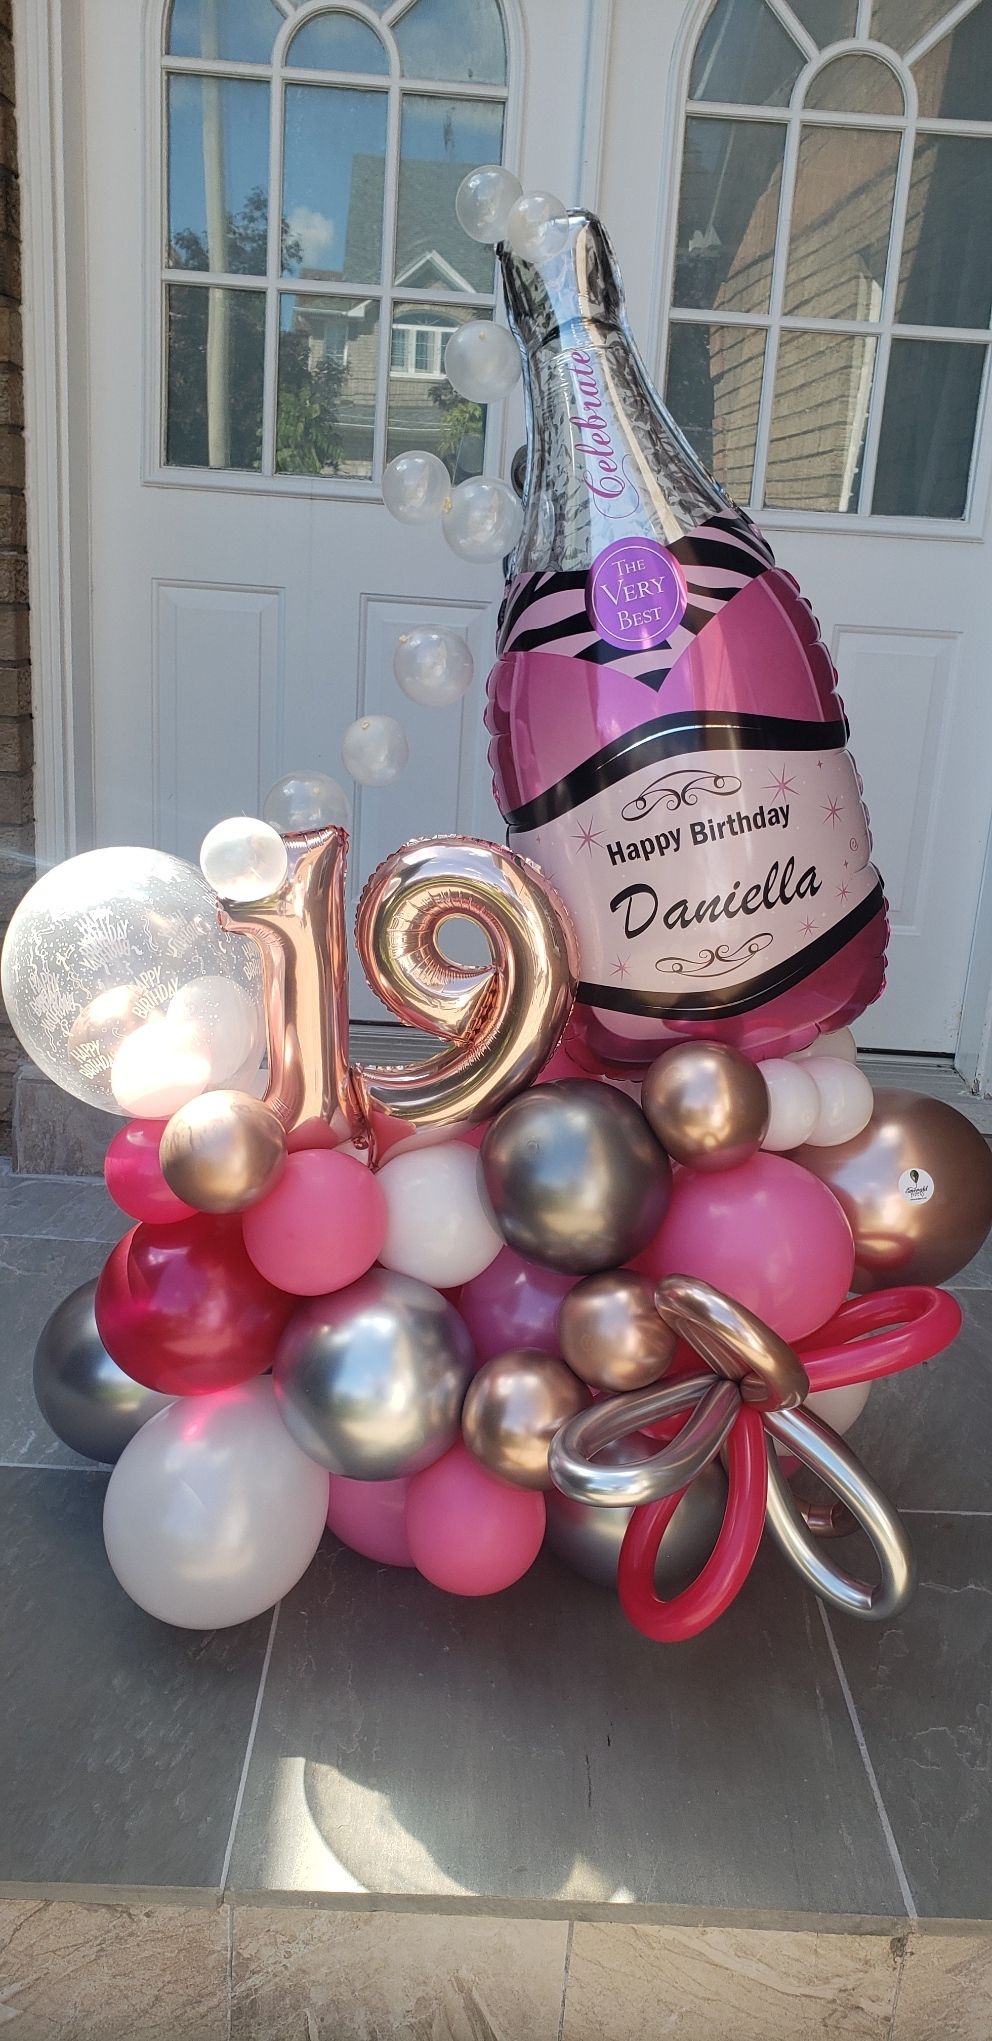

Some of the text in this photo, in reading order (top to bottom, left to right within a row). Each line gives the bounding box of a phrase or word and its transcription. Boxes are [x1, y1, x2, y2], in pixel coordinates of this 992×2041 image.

[569, 350, 639, 519] Celebrate
[612, 559, 646, 576] THE
[600, 576, 666, 606] VERY
[617, 607, 662, 631] BEST
[606, 804, 791, 866] Happy Birthday
[609, 855, 823, 939] Daniella
[131, 975, 179, 1019] BIRTHDAY
[216, 824, 581, 1135] 19
[70, 1040, 101, 1064] HAPPY
[79, 1051, 115, 1080] BIRTHDA
